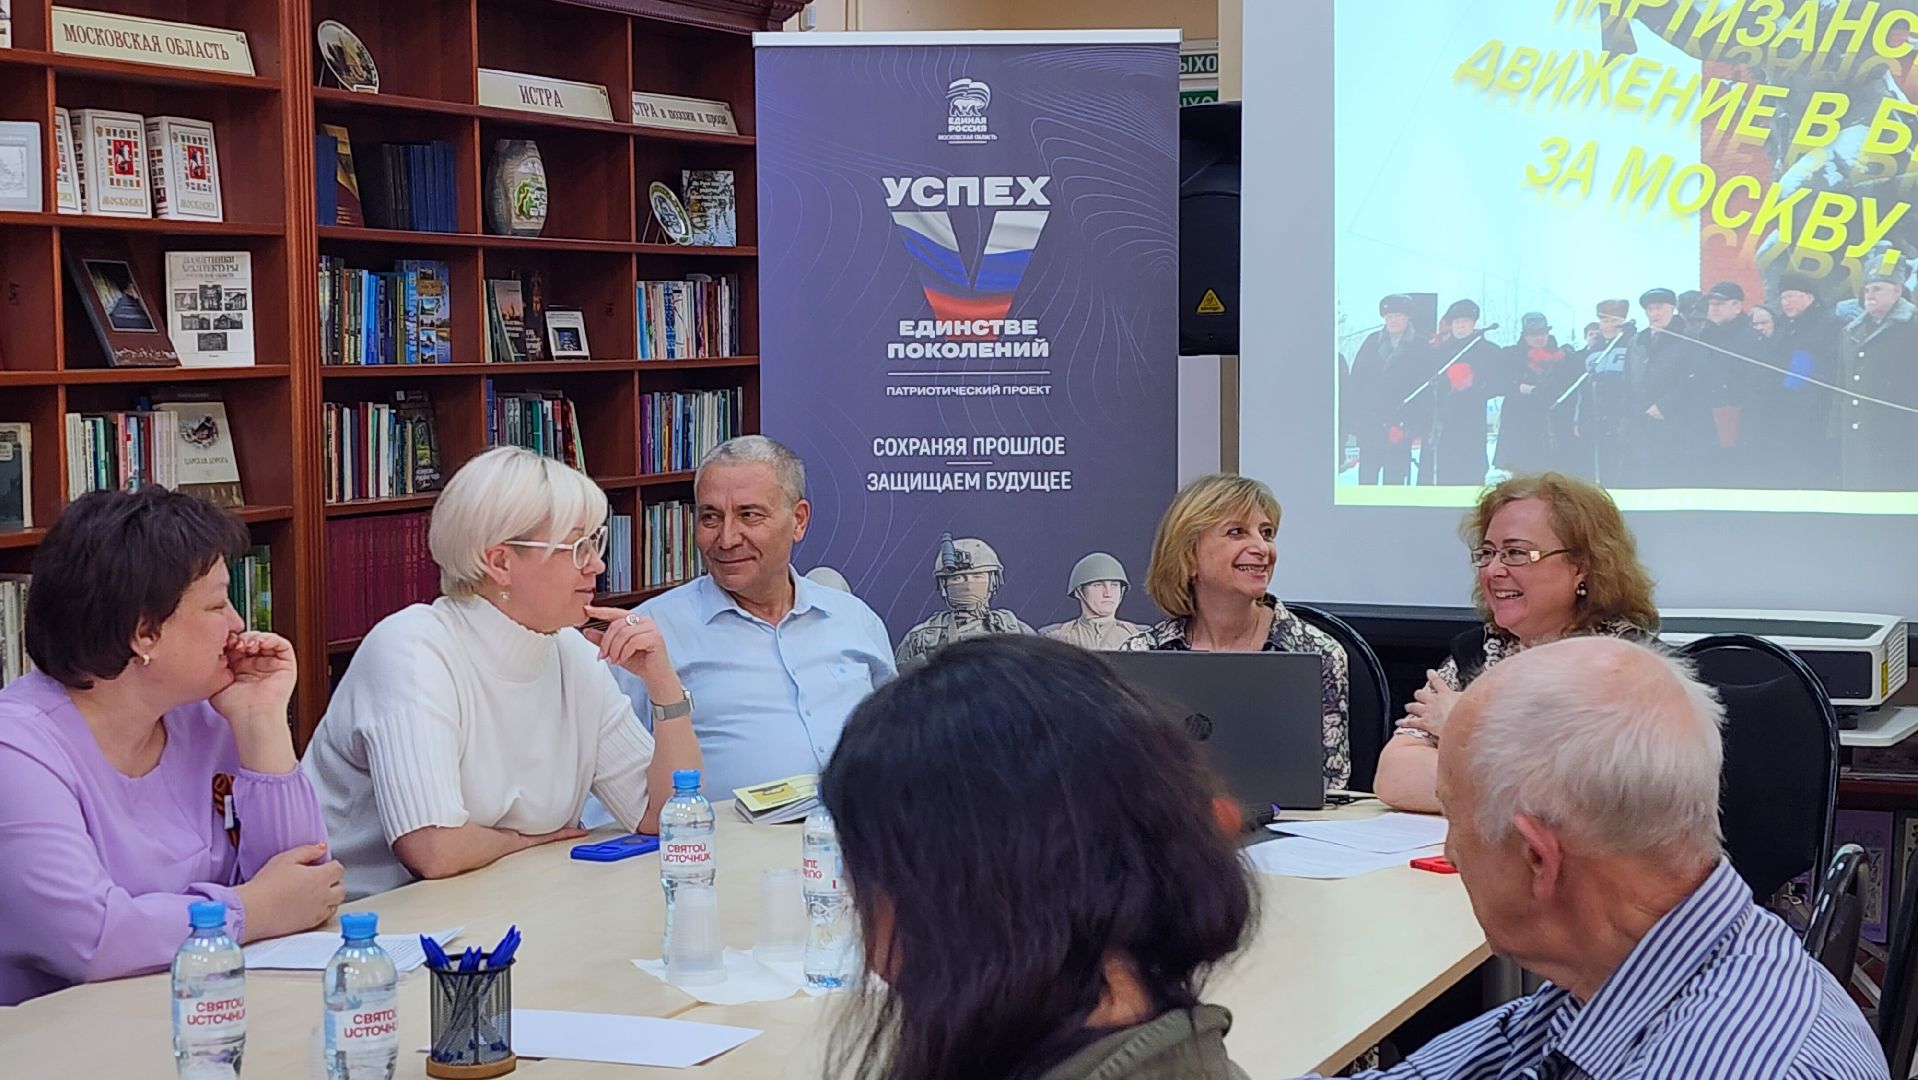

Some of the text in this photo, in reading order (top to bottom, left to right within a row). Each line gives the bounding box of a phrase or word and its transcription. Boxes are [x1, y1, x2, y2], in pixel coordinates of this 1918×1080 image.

[62, 23, 230, 61] МОСКОВСКАЯ ОБЛАСТЬ
[1180, 55, 1217, 73] ЫХО
[518, 84, 564, 108] ИСТРА
[1452, 39, 1918, 163] ДВИЖЕНИЕ В Б
[632, 102, 658, 118] СТРА
[704, 113, 728, 127] прозе
[948, 117, 987, 125] ЕДИНАЯ
[948, 125, 987, 133] РОССИЯ
[1525, 136, 1599, 195] ЗА
[881, 176, 1052, 207] УСПЕХ
[899, 319, 1038, 338] ЕДИНСТВЕ
[887, 338, 1050, 358] ПОКОЛЕНИЙ
[886, 385, 1051, 396] ПАТРИОТИЧЕСКИЙ ПРОЕКТ
[873, 436, 1066, 456] СОХРАНЯЯ ПРОШЛОЕ
[866, 471, 1072, 493] ЗАЩИЩАЕМ БУДУЩЕЕ
[667, 842, 707, 853] СВЯТОЙ
[662, 852, 711, 863] ИСТОЧНИК
[186, 1008, 245, 1025] ИСТОЧНИ
[352, 1008, 397, 1025] СВЯТО
[344, 1021, 398, 1039] ИСТОЧН
